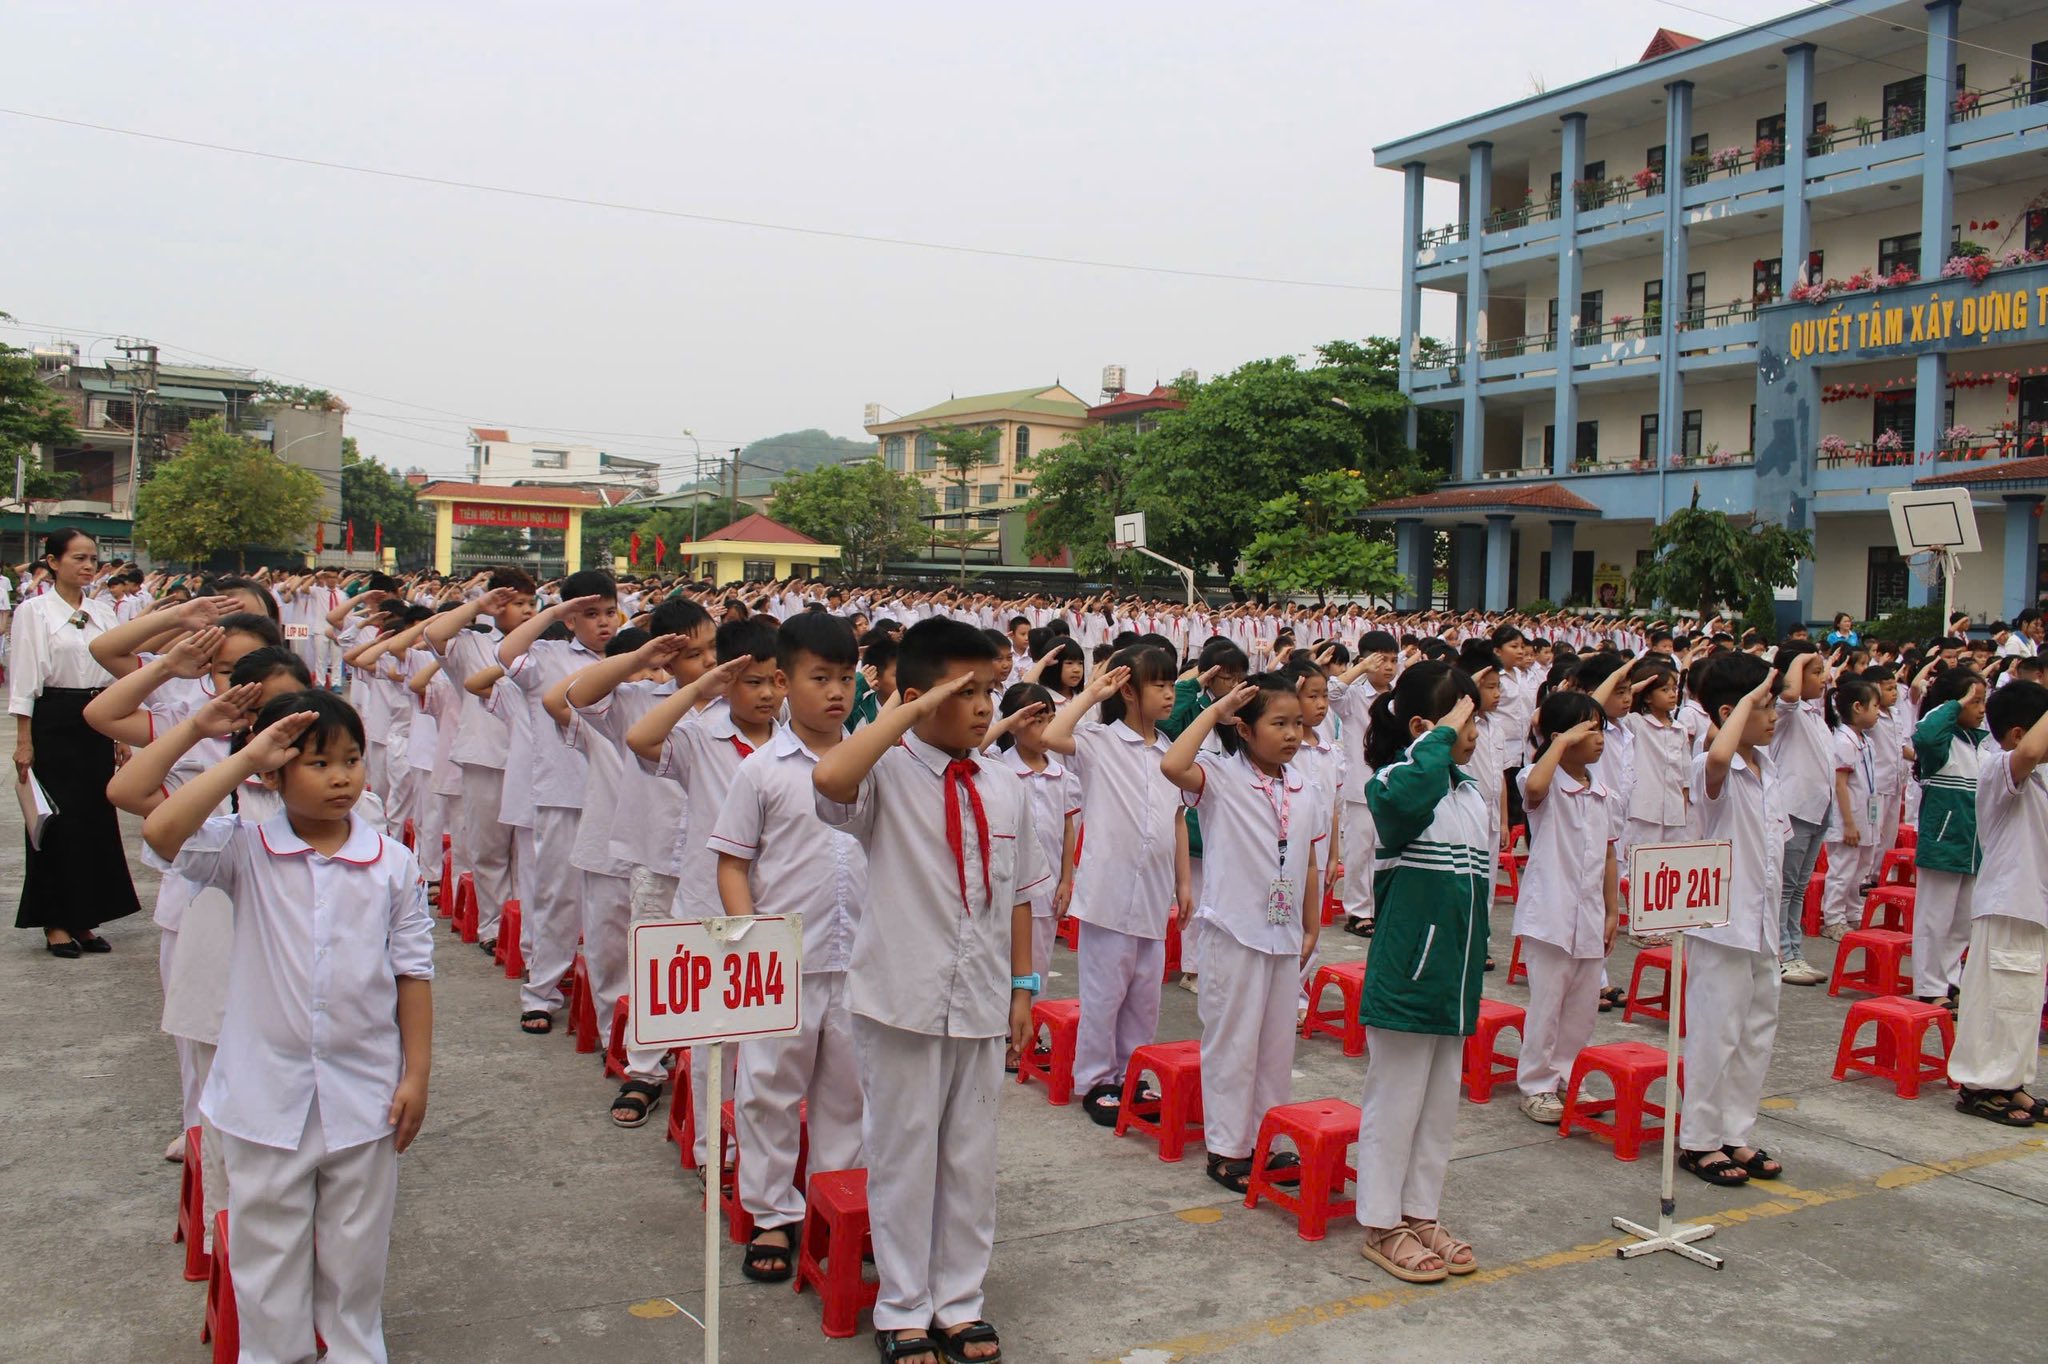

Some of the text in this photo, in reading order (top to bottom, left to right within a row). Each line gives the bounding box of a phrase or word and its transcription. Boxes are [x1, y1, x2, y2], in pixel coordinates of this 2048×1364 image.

[1790, 303, 1853, 360] QUYẾT
[1858, 300, 1903, 348] TÂM
[1910, 293, 1955, 342] XÂY
[1961, 290, 2028, 343] DỰNG
[1644, 862, 1721, 912] LỚP 2A1
[650, 944, 785, 1016] LỚP 3A4
